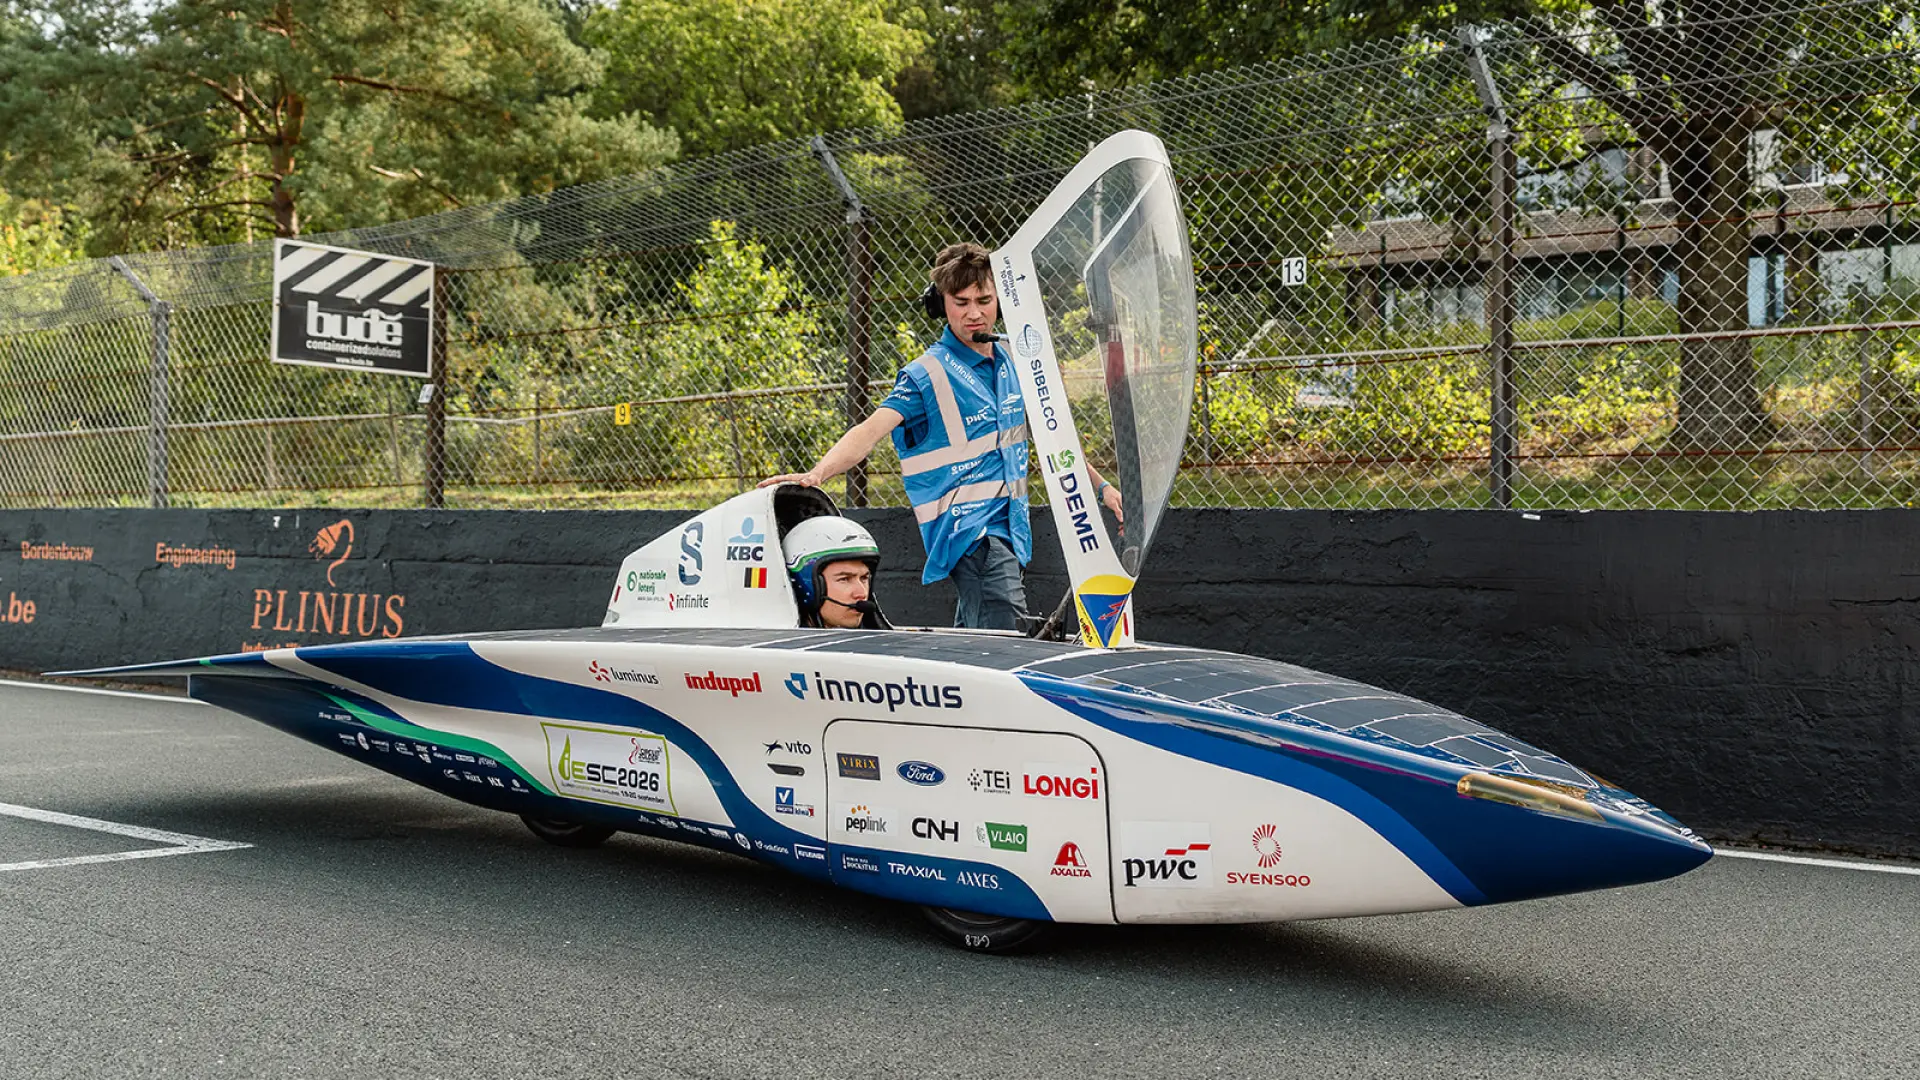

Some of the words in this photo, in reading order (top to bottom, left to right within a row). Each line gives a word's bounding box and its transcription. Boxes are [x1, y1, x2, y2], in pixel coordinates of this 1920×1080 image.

[1284, 260, 1304, 283] 13
[1030, 358, 1057, 431] SIBELCO
[1059, 472, 1100, 554] DEME
[20, 540, 94, 562] Bordenbouw
[155, 542, 237, 570] Engineering
[726, 546, 764, 561] KBC
[640, 570, 667, 580] nationale
[638, 582, 656, 595] loterij
[0, 591, 37, 624] .be
[676, 594, 709, 609] infinite
[251, 588, 405, 638] PLINIUS
[611, 667, 660, 686] luminus
[684, 672, 762, 697] indupol
[816, 672, 963, 712] innoptus
[785, 741, 812, 755] vito
[906, 765, 936, 782] Ford
[846, 815, 887, 833] peplink
[912, 818, 959, 842] CNH
[991, 830, 1025, 845] VLAIO
[887, 862, 947, 881] TRAXIAL
[1050, 867, 1092, 878] AXALTA
[1122, 857, 1197, 887] pwc
[1227, 872, 1311, 887] SYENSQO
